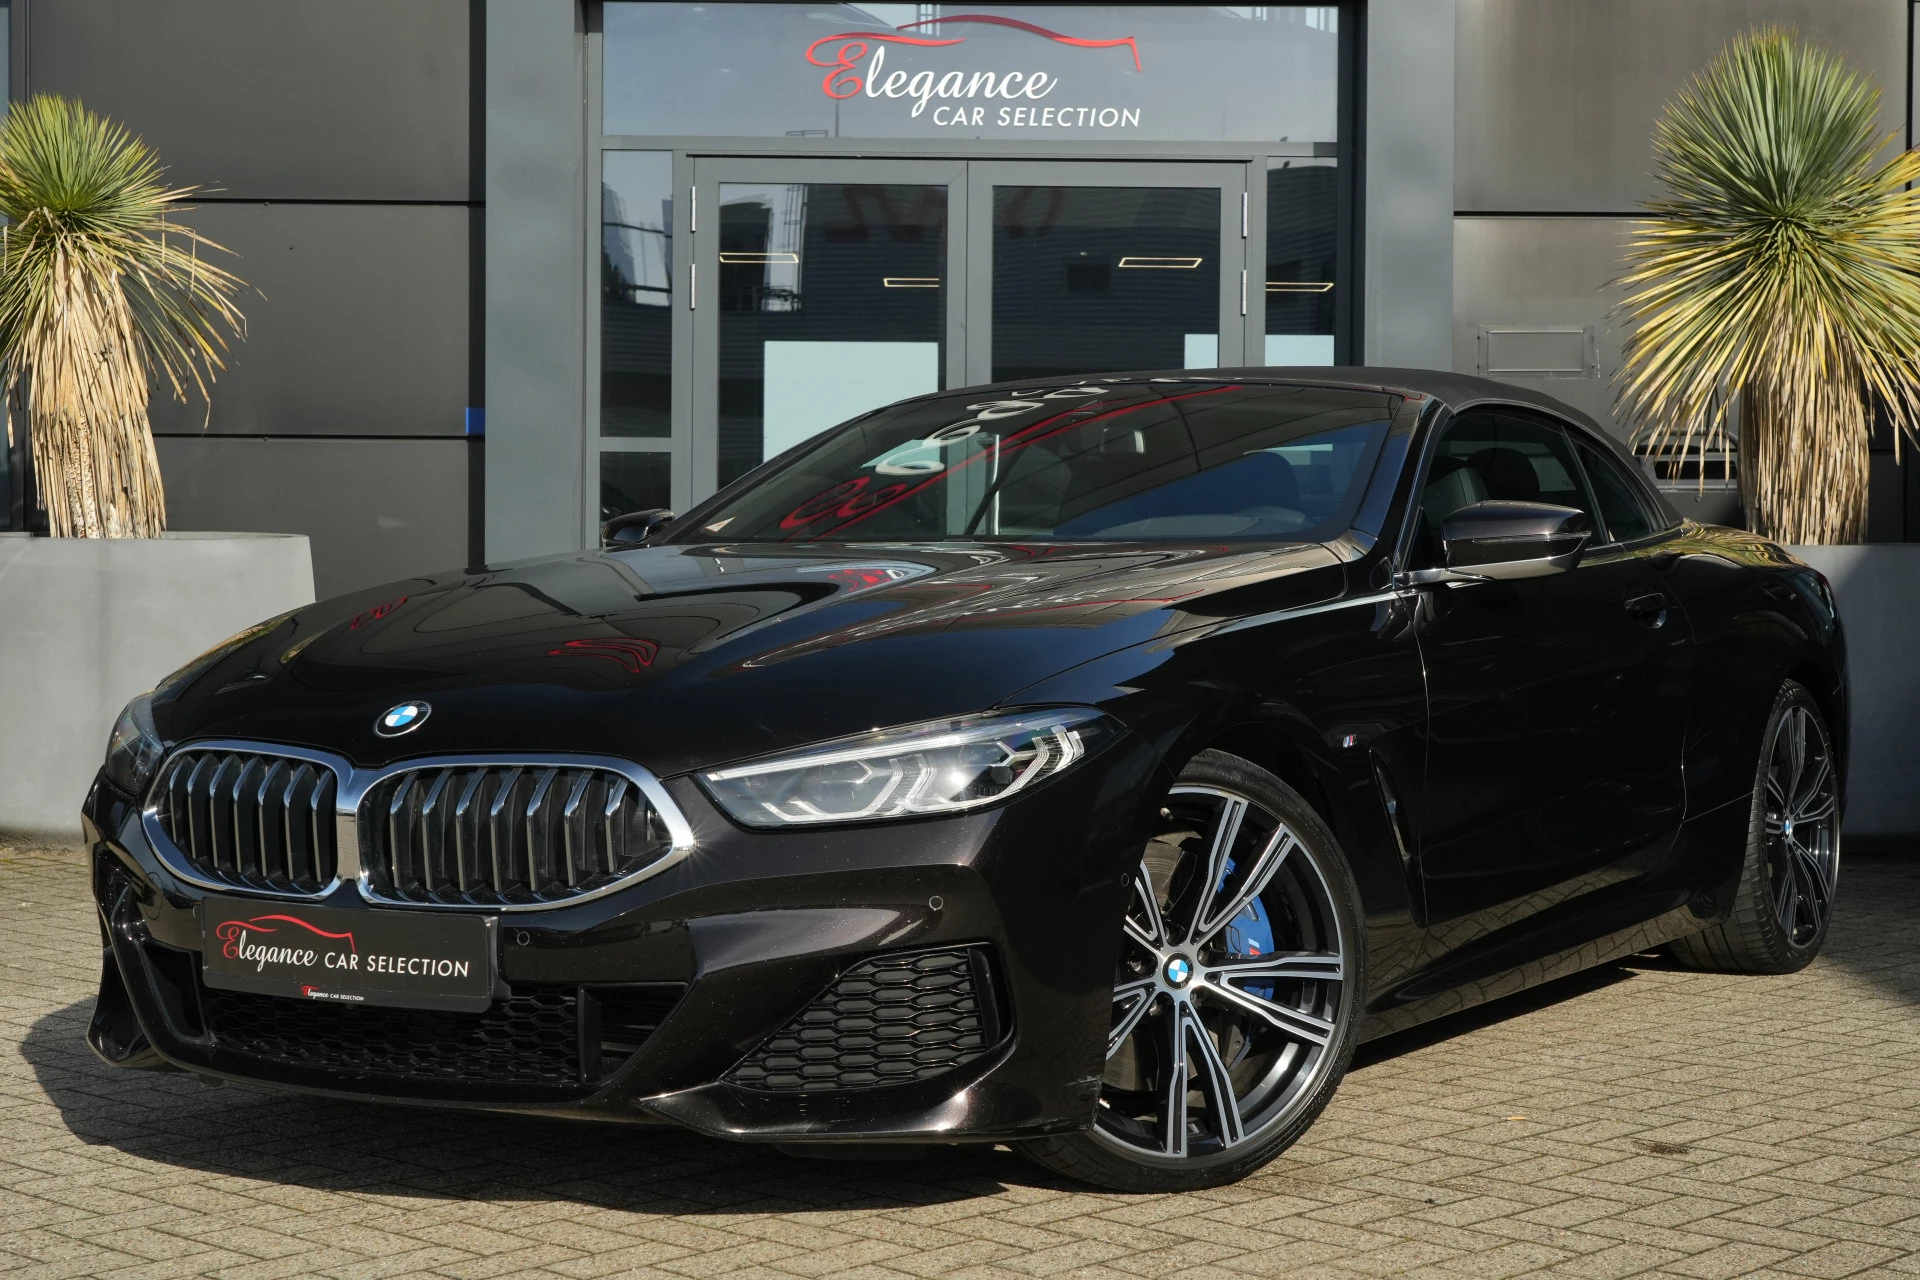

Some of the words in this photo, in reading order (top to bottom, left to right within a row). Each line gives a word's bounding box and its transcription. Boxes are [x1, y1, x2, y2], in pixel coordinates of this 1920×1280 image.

[805, 32, 1058, 119] Elegance
[933, 106, 985, 127] CAR
[997, 107, 1141, 128] SELECTION
[216, 921, 318, 972] Elegance
[324, 952, 358, 970] CAR
[367, 955, 469, 978] SELECTION
[301, 985, 329, 999] Elegance
